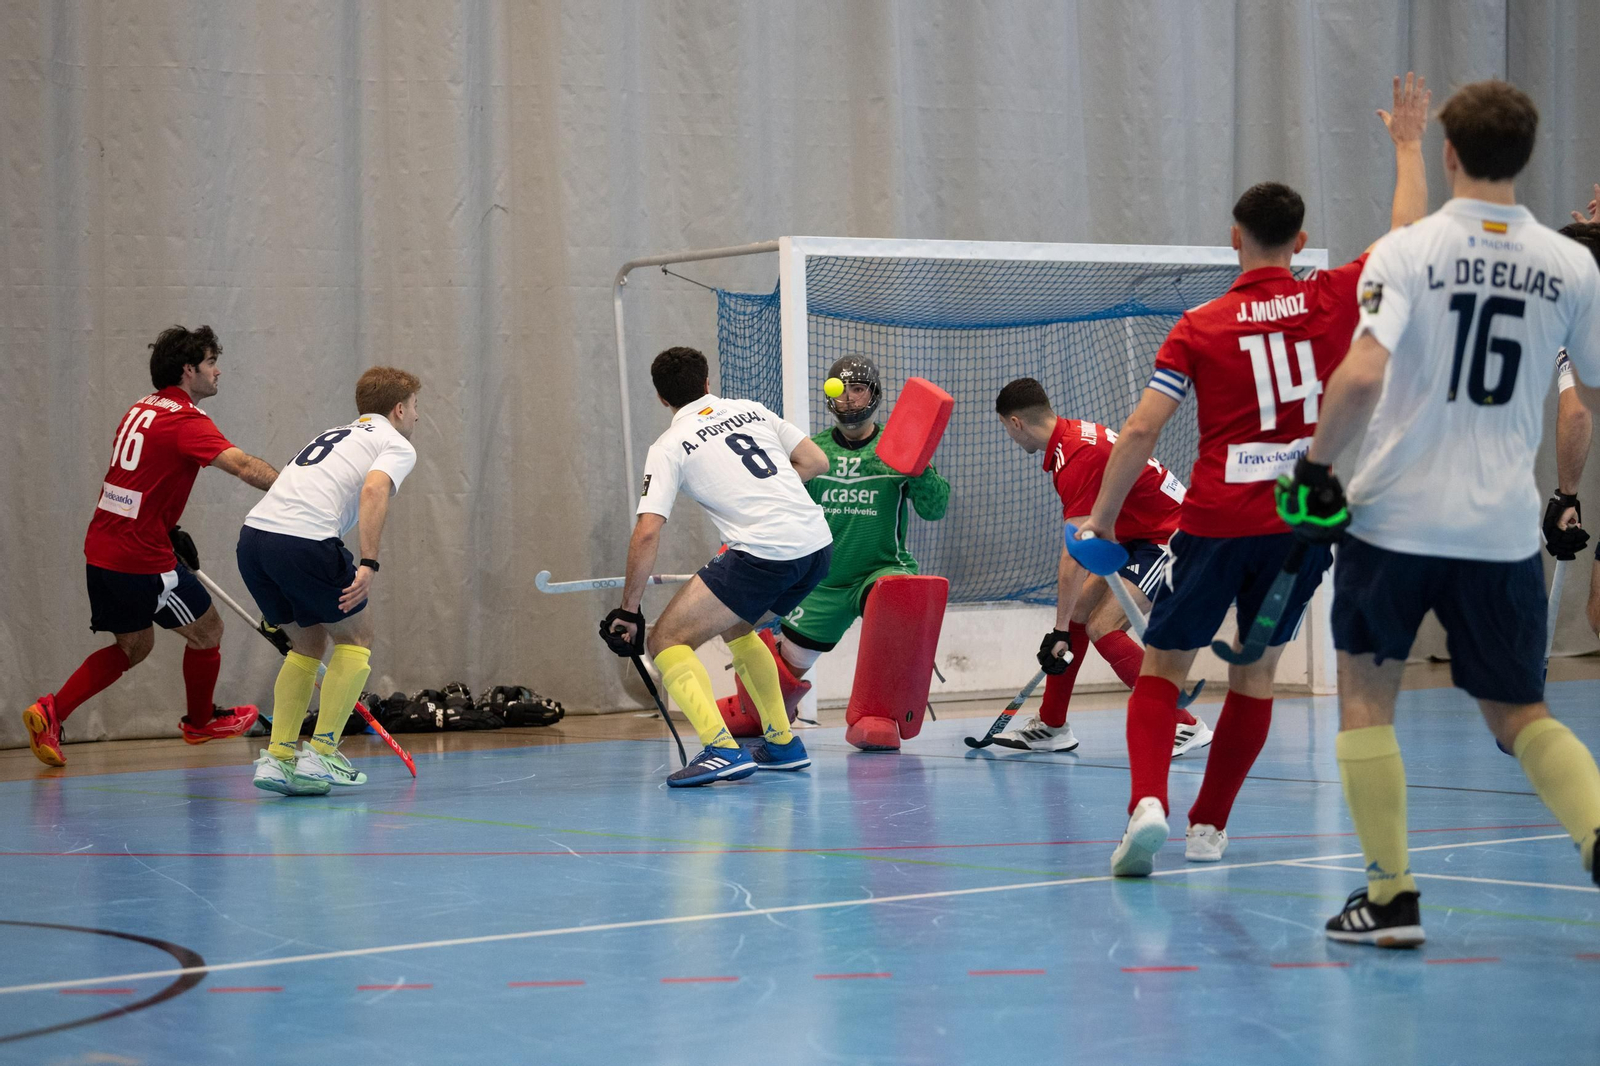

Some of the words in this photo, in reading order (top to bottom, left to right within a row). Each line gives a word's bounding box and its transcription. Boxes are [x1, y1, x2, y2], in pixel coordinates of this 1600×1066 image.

[1480, 238, 1523, 252] MADRID
[1455, 258, 1485, 285] DE
[1491, 261, 1563, 303] ELIAS
[1236, 292, 1309, 324] J.MUÑOZ
[1447, 292, 1527, 407] 16
[1238, 332, 1323, 432] 14
[111, 407, 157, 471] 16
[287, 429, 352, 467] 8
[681, 440, 699, 455] A.
[725, 432, 778, 479] 8
[836, 456, 862, 477] 32
[1236, 445, 1310, 466] Traveleand
[829, 488, 879, 504] caser
[844, 507, 878, 516] Helvetia
[592, 579, 617, 589] OBO
